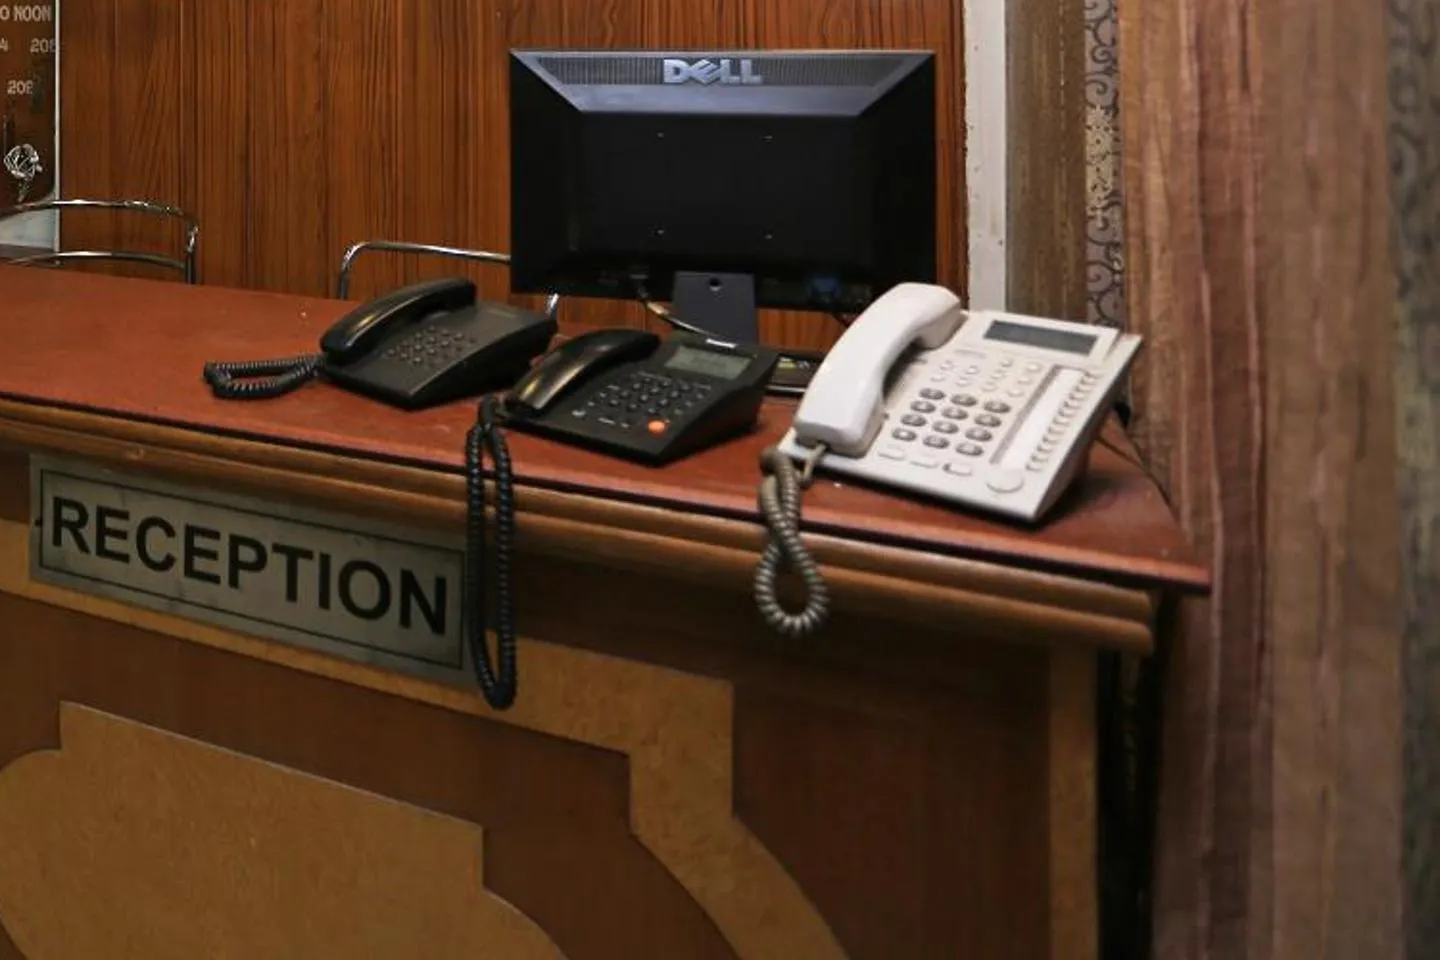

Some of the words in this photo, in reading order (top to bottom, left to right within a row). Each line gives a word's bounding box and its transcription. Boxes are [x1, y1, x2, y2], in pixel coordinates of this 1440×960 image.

[13, 4, 52, 22] NOON
[663, 58, 763, 84] DELL
[52, 496, 446, 635] RECEPTION
